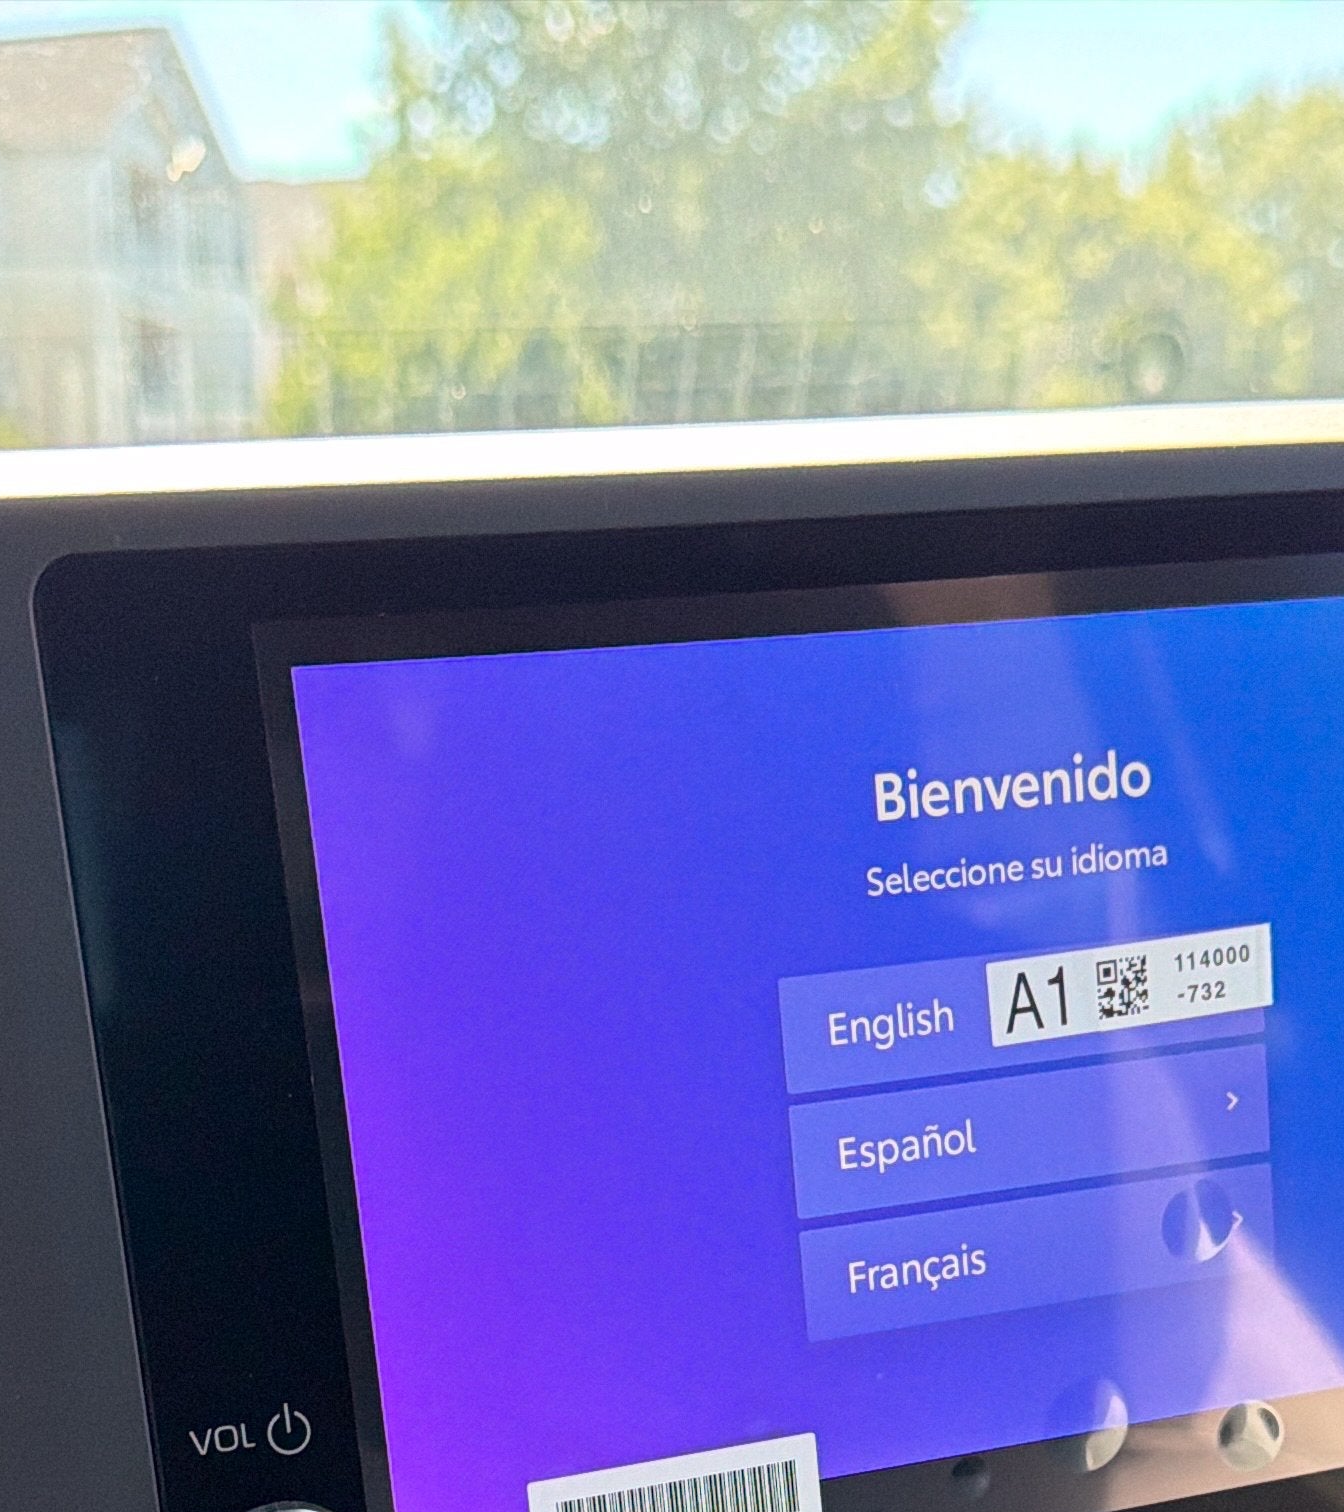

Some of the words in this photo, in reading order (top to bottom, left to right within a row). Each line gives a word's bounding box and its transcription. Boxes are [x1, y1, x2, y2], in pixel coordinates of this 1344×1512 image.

[873, 749, 1153, 822] Bienvenido
[865, 855, 1025, 898] Seleccione
[1030, 853, 1063, 880] su
[1070, 840, 1169, 876] idioma
[1173, 943, 1252, 974] 114000
[1005, 964, 1069, 1035] A1
[1177, 980, 1227, 1005] -732
[828, 998, 956, 1051] English
[837, 1119, 977, 1174] Español
[847, 1243, 987, 1295] Français
[188, 1422, 256, 1456] VOL
